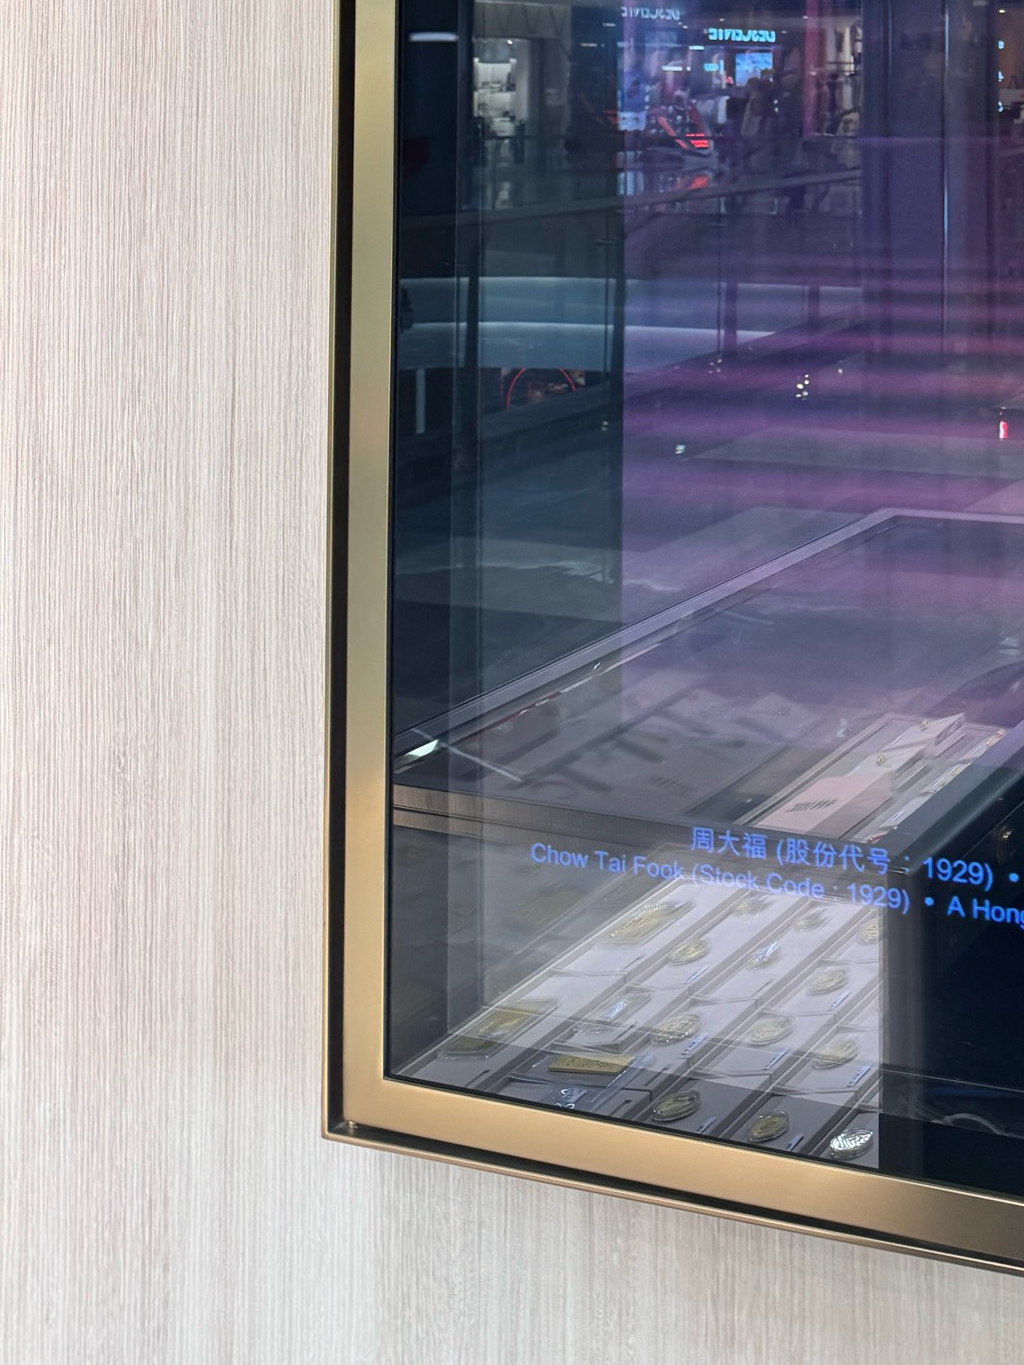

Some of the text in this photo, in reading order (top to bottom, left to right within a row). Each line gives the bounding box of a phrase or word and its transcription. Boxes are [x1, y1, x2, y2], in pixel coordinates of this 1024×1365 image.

[690, 826, 767, 859] 周大福
[530, 842, 588, 869] Chow
[594, 850, 627, 873] Tai
[633, 855, 682, 879] Fook
[691, 863, 759, 891] (Stock
[766, 872, 825, 899] Code
[847, 882, 910, 914] 1929)
[946, 896, 966, 918] A
